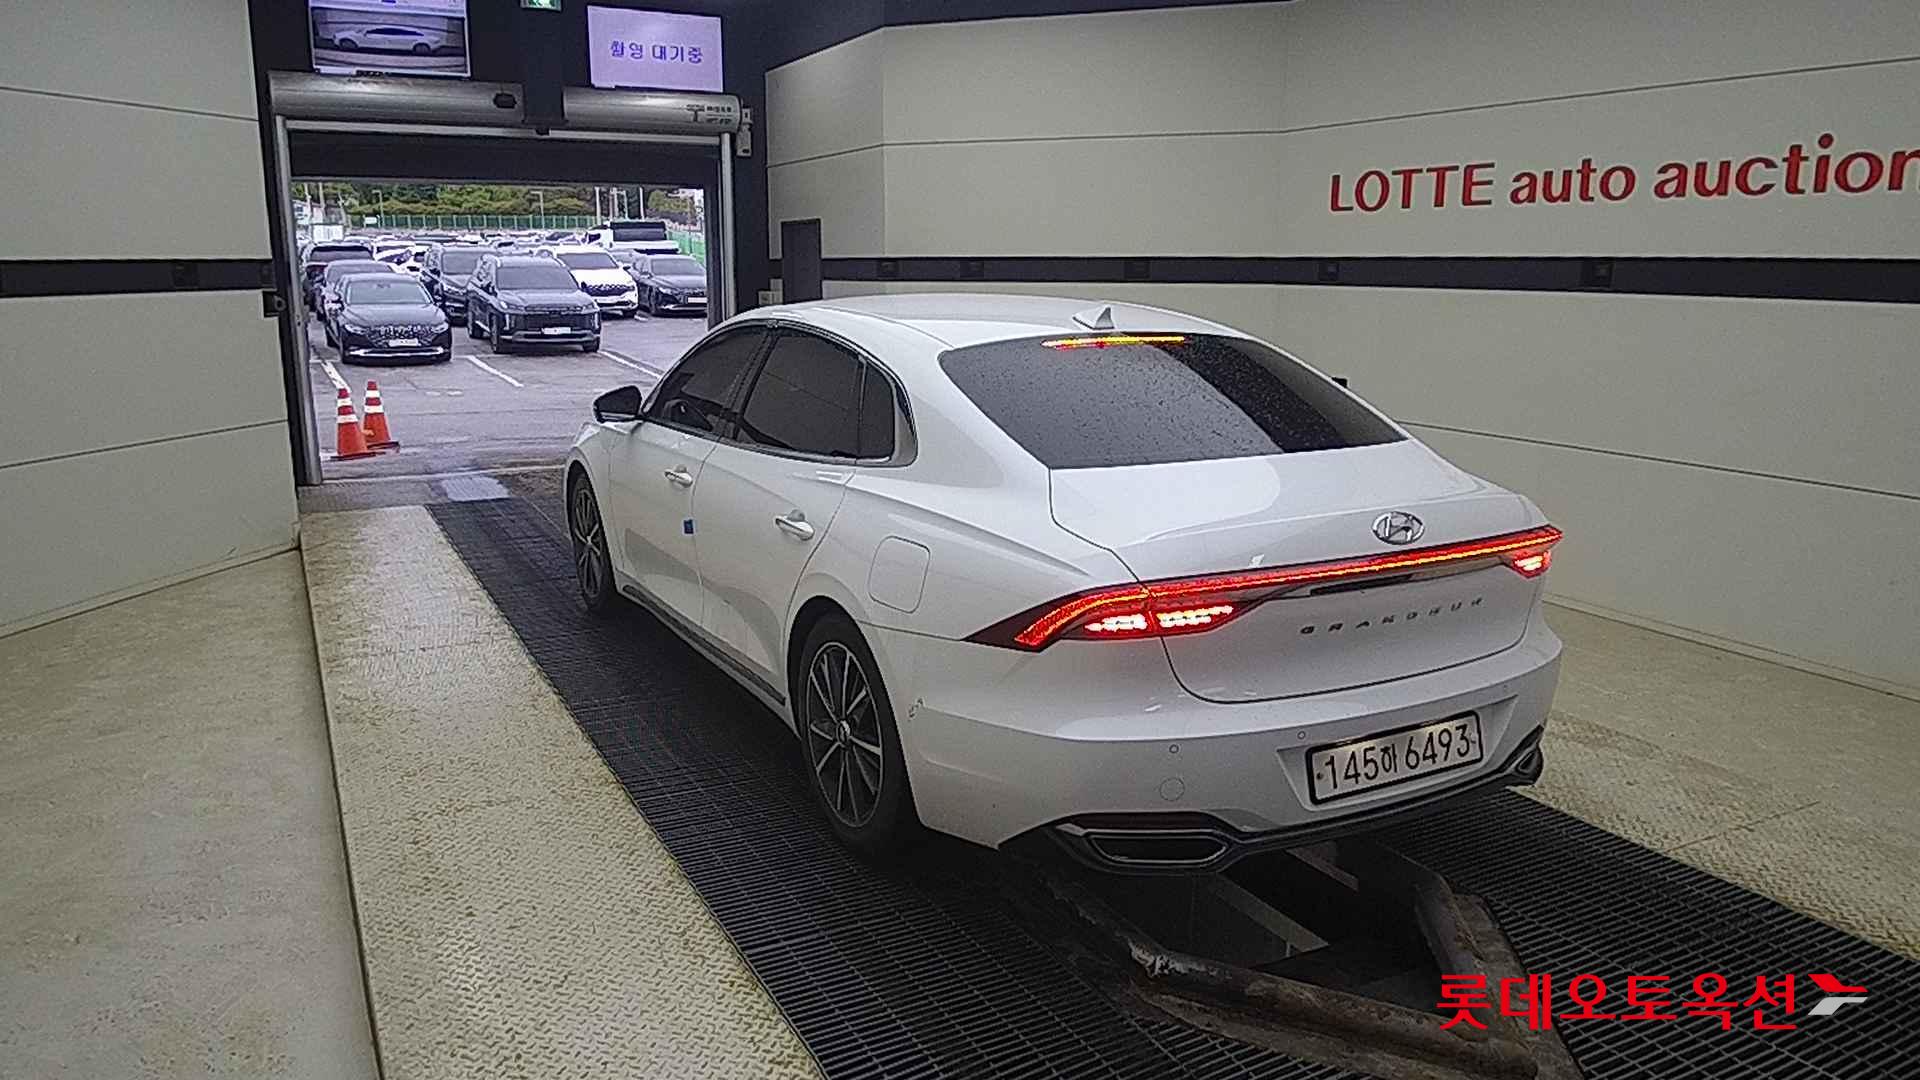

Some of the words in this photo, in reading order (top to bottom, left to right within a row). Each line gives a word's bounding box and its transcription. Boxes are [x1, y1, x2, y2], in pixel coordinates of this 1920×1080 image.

[651, 44, 704, 64] 대기중
[1330, 162, 1496, 212] LOTTE
[1510, 158, 1636, 205] auto
[1405, 723, 1471, 770] 6493
